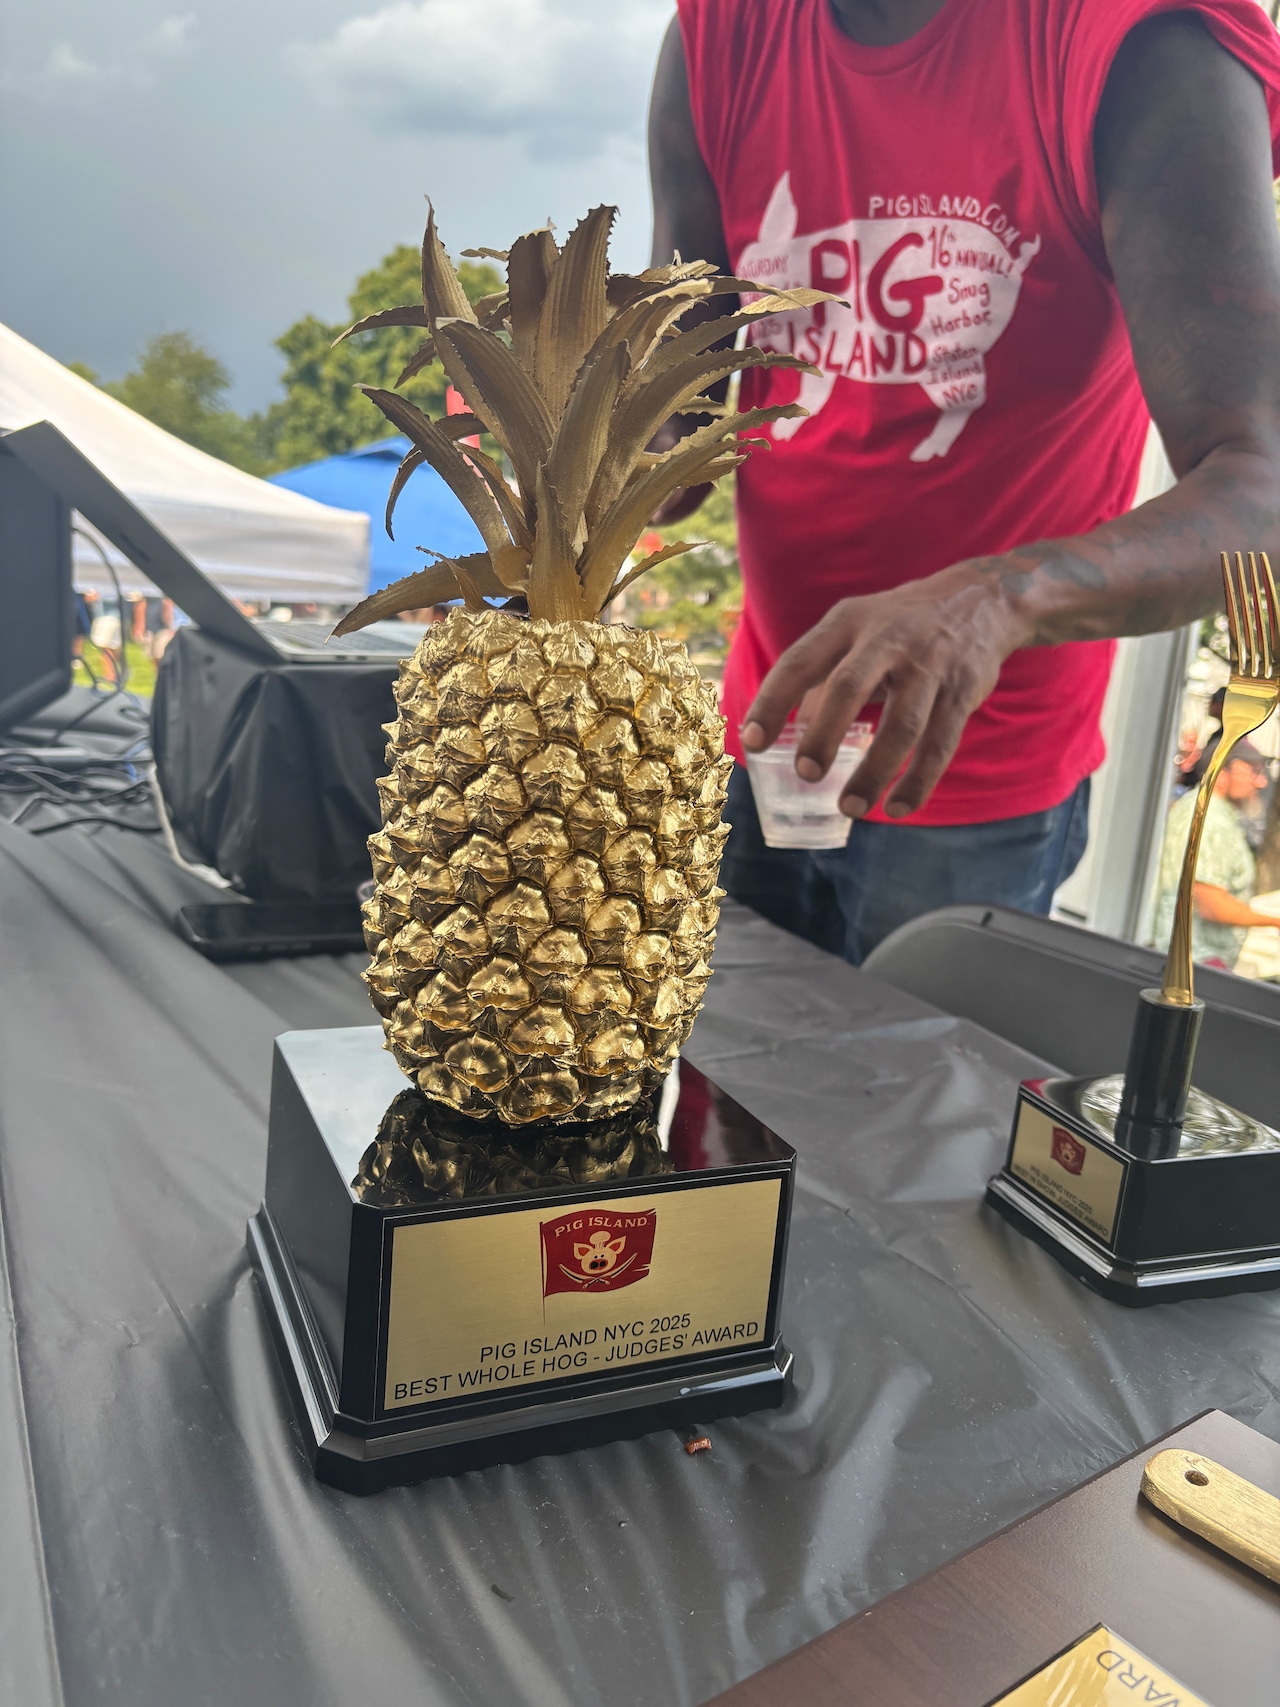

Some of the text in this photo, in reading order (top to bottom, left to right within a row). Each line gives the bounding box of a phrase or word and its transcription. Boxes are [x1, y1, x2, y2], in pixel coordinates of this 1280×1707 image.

[868, 194, 1021, 249] PIGISLAND.COM
[809, 231, 944, 333] PIG
[947, 276, 991, 308] Snug
[787, 321, 927, 378] ISLAND
[932, 342, 977, 363] Staten
[926, 361, 984, 385] Island
[943, 383, 979, 409] NYC
[554, 1216, 648, 1239] PIG ISLAND
[480, 1313, 691, 1363] PIG ISLAND NYC 2025
[394, 1374, 453, 1400] BEST
[458, 1362, 536, 1388] WHOLE
[542, 1353, 588, 1374] HOG
[605, 1334, 689, 1363] JUDGES'
[691, 1321, 759, 1346] AWARD
